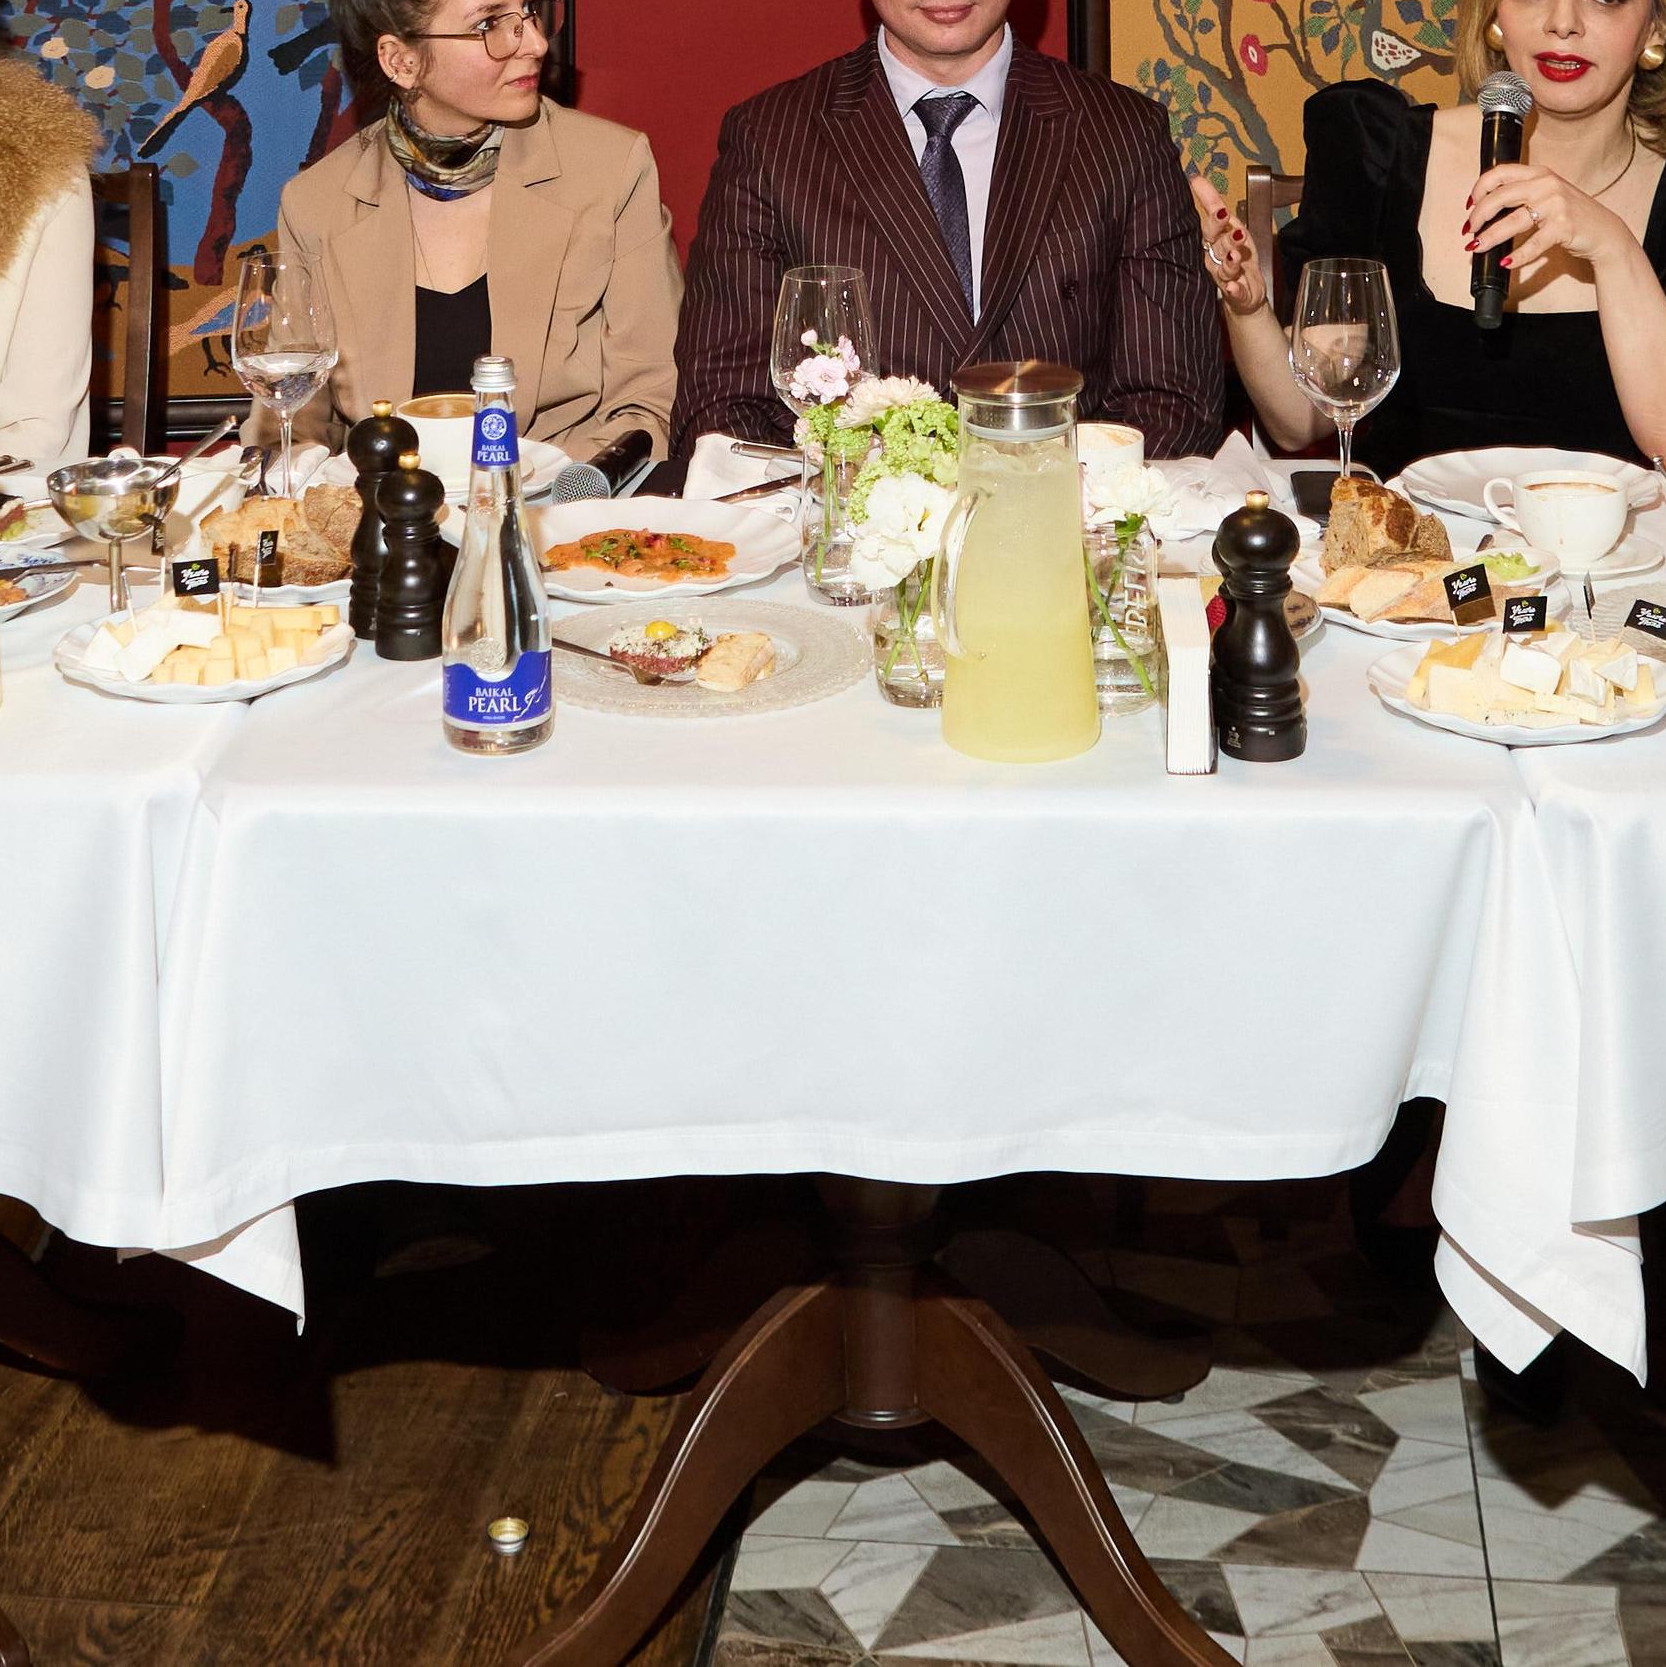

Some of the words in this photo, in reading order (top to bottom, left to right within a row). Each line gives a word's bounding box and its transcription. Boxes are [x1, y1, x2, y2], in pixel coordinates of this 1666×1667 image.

[477, 450, 512, 462] PEARL
[475, 687, 514, 697] BAIKAL
[468, 696, 521, 713] PEARL
